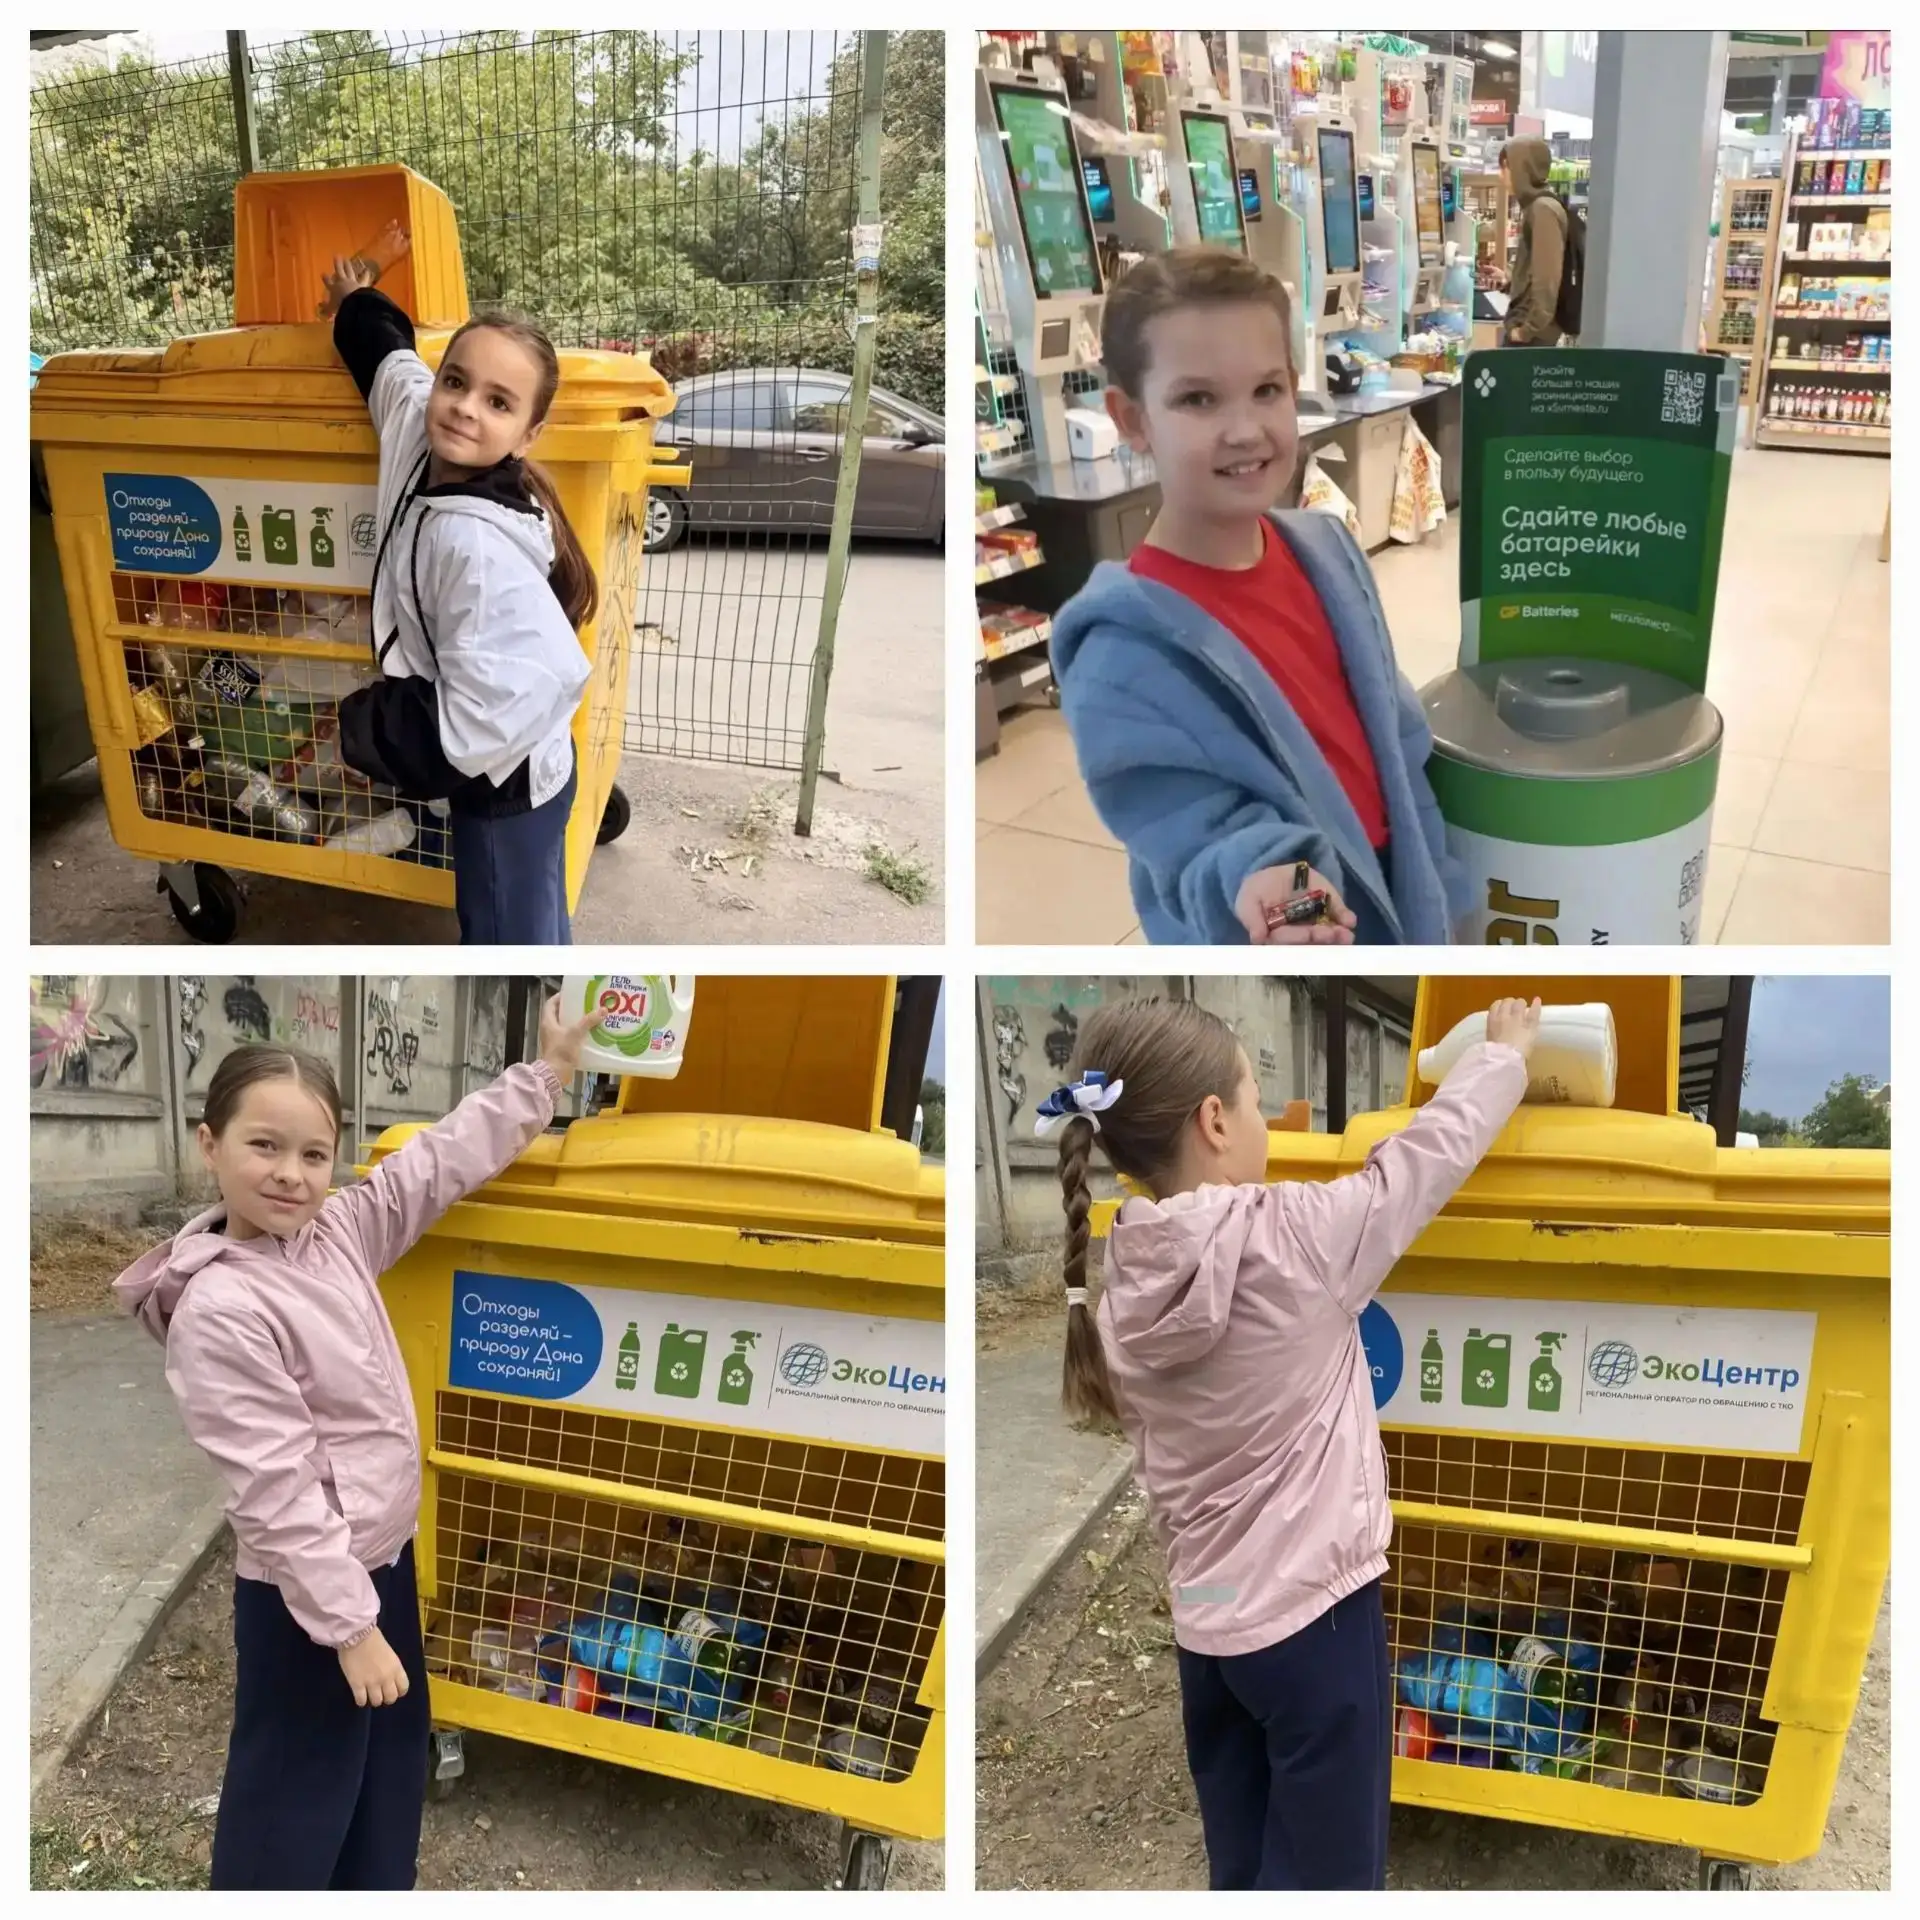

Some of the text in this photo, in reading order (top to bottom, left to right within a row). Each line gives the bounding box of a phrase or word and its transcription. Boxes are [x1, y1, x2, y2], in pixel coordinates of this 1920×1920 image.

[1532, 365, 1576, 376] Узнайте
[1531, 379, 1573, 389] больше
[1574, 380, 1583, 388] о
[1530, 404, 1545, 413] на
[1504, 448, 1634, 468] Сделайте выбор
[1504, 465, 1644, 483] в пользу будущего
[112, 490, 172, 510] Отходы
[129, 512, 189, 525] разделяй
[1501, 505, 1687, 540] Сдайте любые
[116, 525, 210, 545] природу Дона
[1500, 533, 1641, 557] батарейки
[133, 545, 196, 559] сохраняй!
[1500, 560, 1572, 582] здесь
[1522, 605, 1580, 618] Batteries
[610, 975, 631, 984] ГЕЛЬ
[600, 990, 646, 1017] OXI
[605, 1020, 621, 1028] GEL
[462, 1293, 540, 1321] Отходы
[479, 1320, 559, 1339] разделяй
[459, 1337, 583, 1365] природу Дона
[477, 1360, 560, 1382] сохраняй!
[831, 1359, 945, 1394] ЭкоЦен
[1642, 1355, 1800, 1392] ЭкоЦентр
[775, 1387, 839, 1401] РЕГИОНАЛЬНЫЙ
[840, 1396, 882, 1406] ОПЕРАТОР
[883, 1401, 896, 1409] ПО
[1585, 1390, 1652, 1400] РЕГИОНАЛЬНЫЙ
[1653, 1394, 1698, 1404] ОПЕРАТОР
[1698, 1397, 1711, 1405] ПО
[1712, 1399, 1769, 1409] ОБРАЩЕНИЮ
[1778, 1402, 1794, 1410] ТКО
